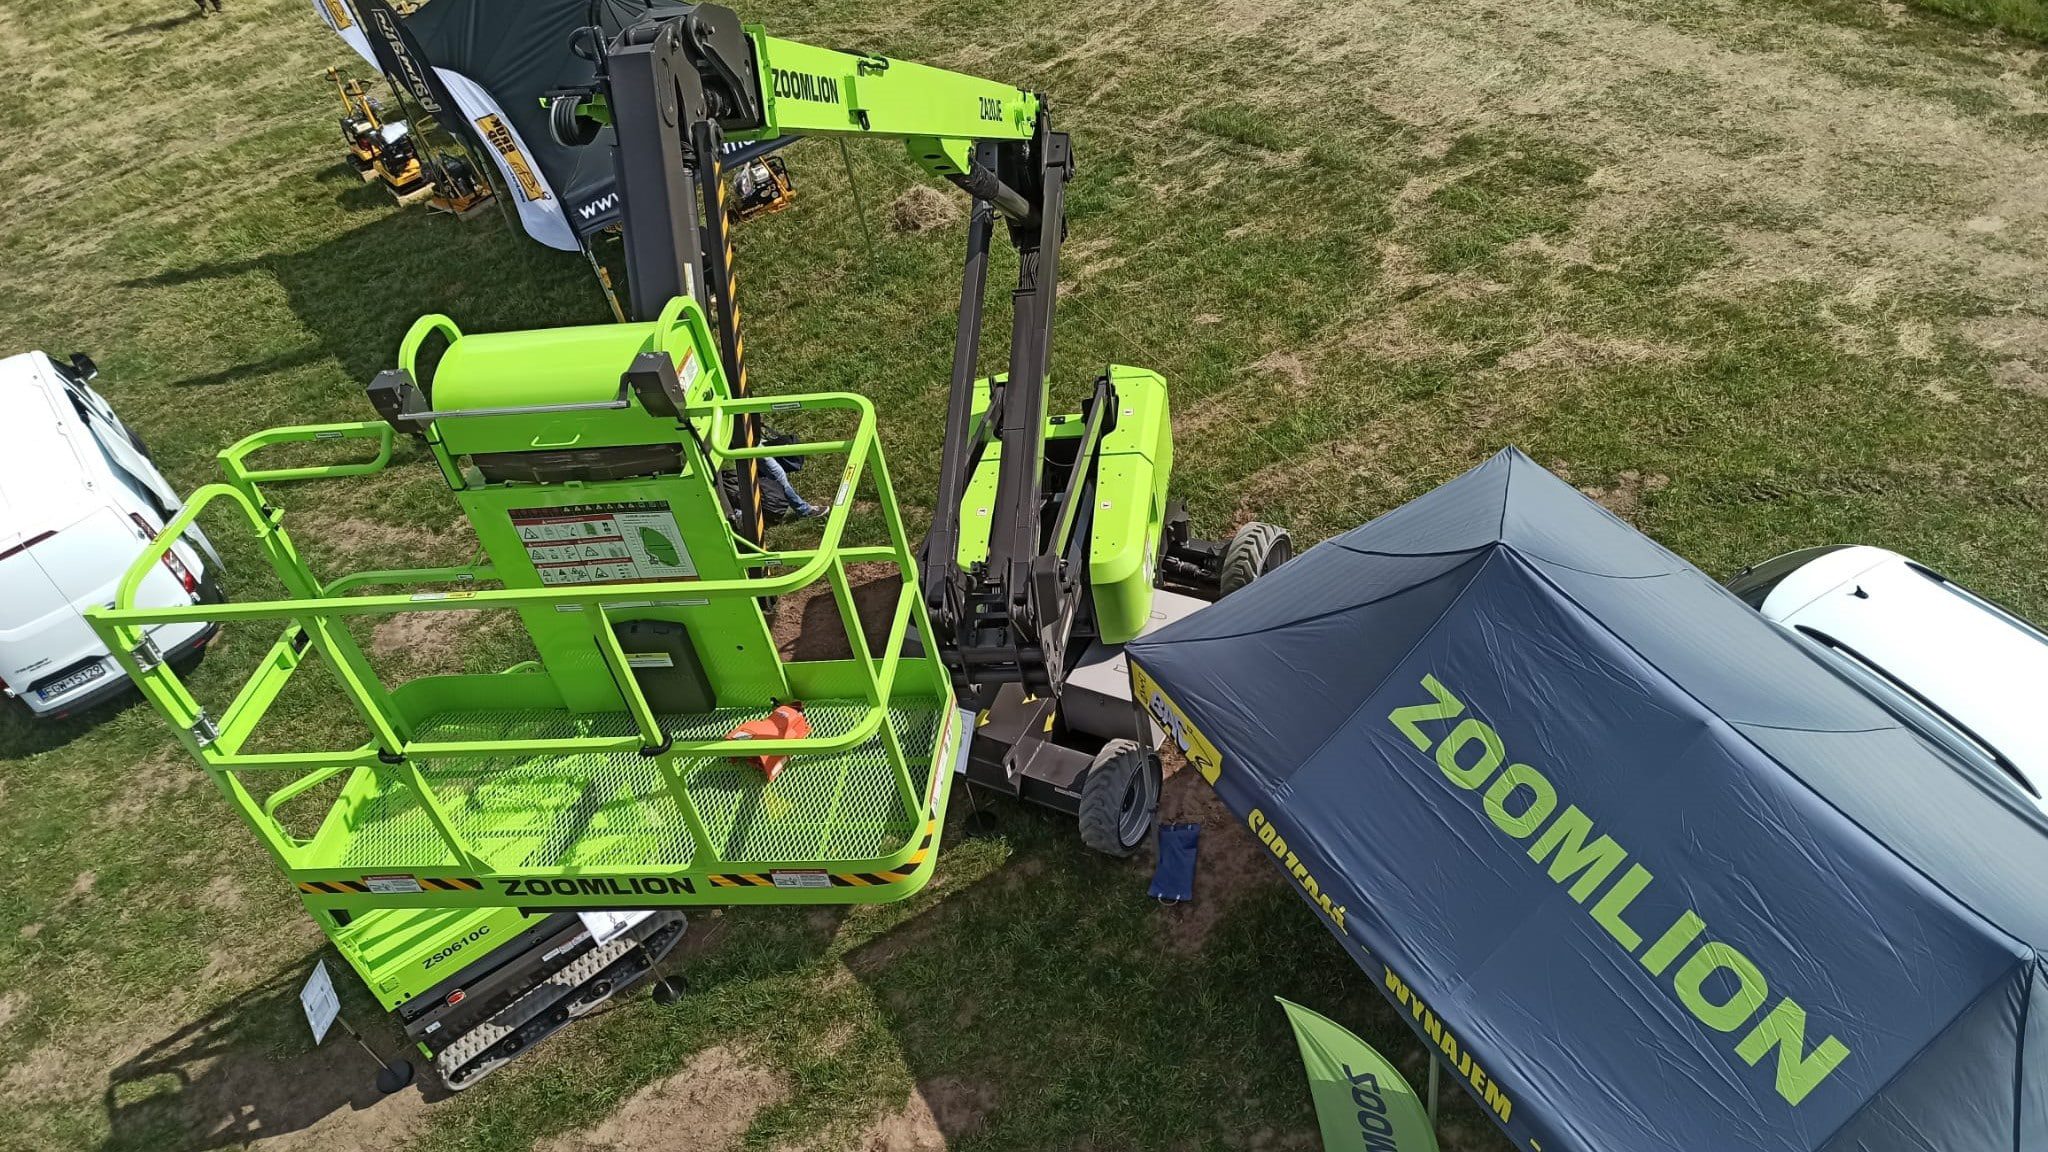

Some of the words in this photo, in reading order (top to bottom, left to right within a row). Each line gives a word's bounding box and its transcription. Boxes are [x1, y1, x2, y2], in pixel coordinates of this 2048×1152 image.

[772, 69, 839, 104] ZOOMLION
[498, 878, 697, 897] ZOOMLION
[1389, 674, 1850, 1107] ZOOMLION
[423, 925, 491, 970] ZS0610C
[1384, 965, 1512, 1123] WYNAJEM
